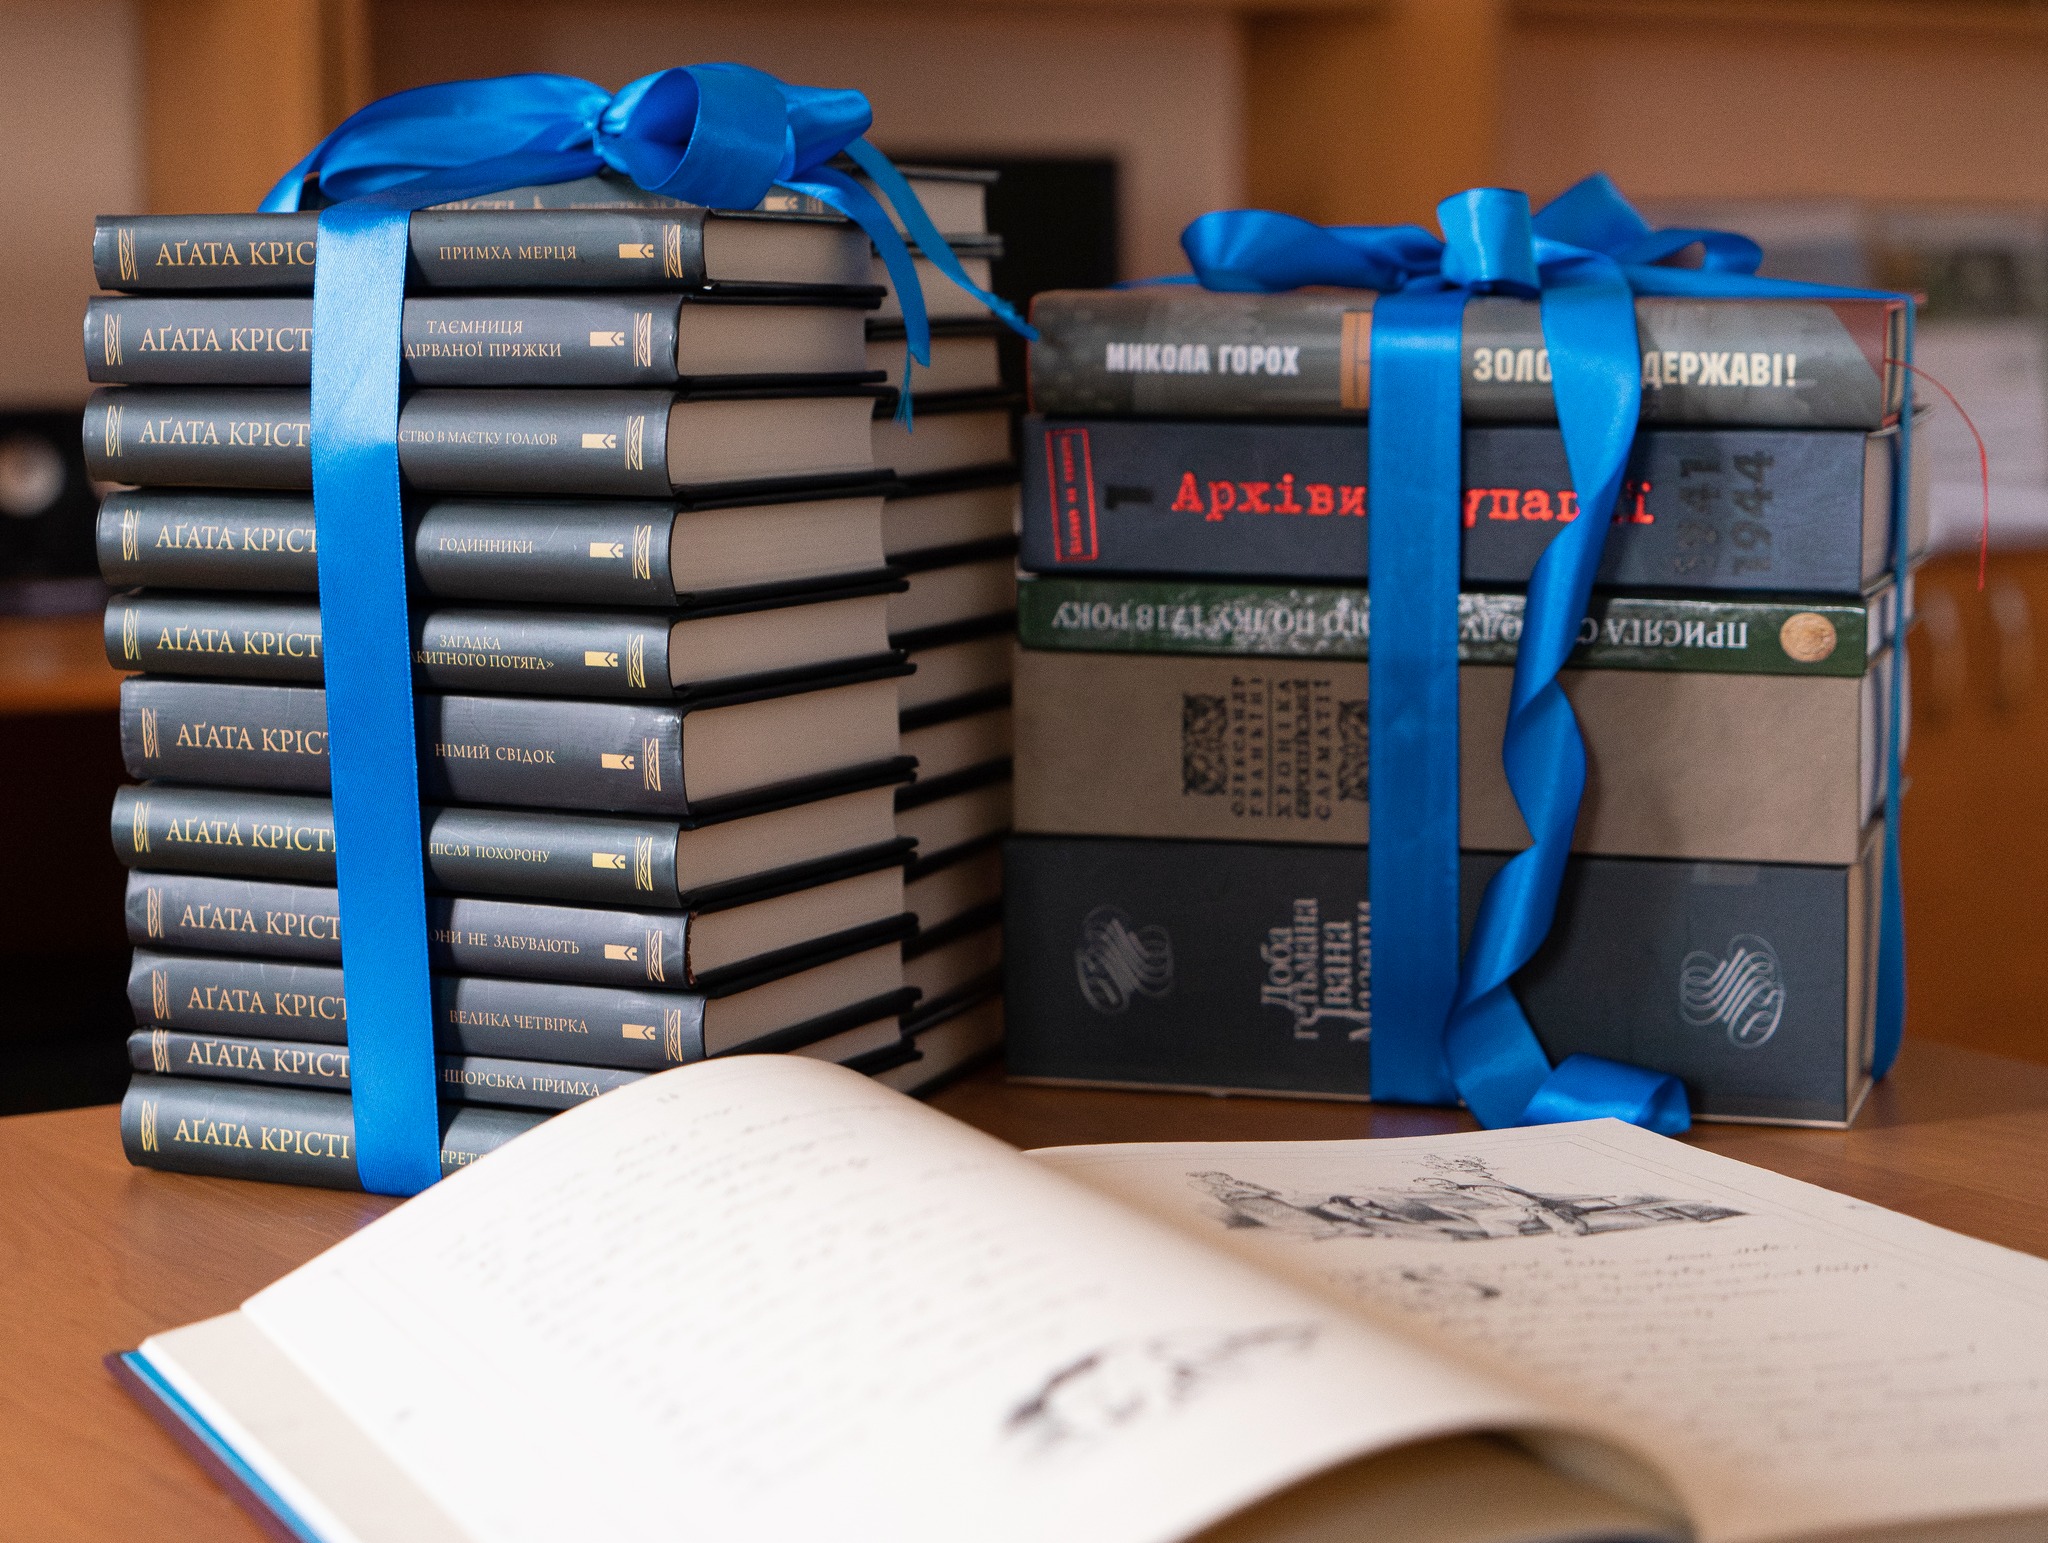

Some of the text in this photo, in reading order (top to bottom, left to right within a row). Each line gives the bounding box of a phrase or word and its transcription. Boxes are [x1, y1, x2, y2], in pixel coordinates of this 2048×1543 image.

[156, 240, 315, 267] АҐАТА КРІС
[439, 245, 577, 261] ПРИМХА МЕРЦЯ
[139, 326, 313, 352] АҐАТА КРІСТ
[427, 320, 523, 336] ТАЄМНИЦЯ
[405, 341, 562, 359] ДІРВАНОЇ ПРЯЖКИ
[1105, 342, 1300, 376] МИКОЛА ГОРОХ
[1473, 347, 1797, 389] ЗОЛО ДЕРЖАВІ!
[139, 419, 310, 447] АҐАТА КРІСТ
[399, 430, 557, 446] СТВО В МАЄТКУ ГОЛЛОВ
[1171, 471, 1367, 522] Архіви
[1731, 450, 1775, 576] 1944
[155, 523, 318, 554] АҐАТА КРІСТ
[439, 537, 533, 554] ГОДИННИКИ
[1052, 601, 1130, 630] РОКУ
[157, 626, 322, 659] АҐАТА КРІСТ
[439, 634, 501, 651] ЗАГАДКА
[1610, 618, 1748, 650] ПРИСЯГА
[411, 651, 554, 670] КИТНОГО ПОТЯГА»
[175, 722, 331, 756] АҐАТА КРІС
[435, 743, 556, 764] НІМИЙ СВІДОК
[166, 816, 243, 847] АҐАТА
[429, 842, 550, 863] ПІСЛЯ ПОХОРОНУ
[180, 903, 340, 940] АҐАТА КРІСТ
[429, 929, 580, 954] ОНИ НЕ ЗАБУВАЮТЬ
[1260, 927, 1295, 1009] Доба
[187, 985, 347, 1021] АҐАТА КРІСТ
[449, 1010, 589, 1034] ВЕЛИКА ЧЕТВІРКА
[186, 1039, 350, 1078] АҐАТА КРІСТ
[439, 1069, 600, 1097] НШОРСЬКА ПРИМХА
[173, 1117, 350, 1159] АҐАТА КРІСТІ
